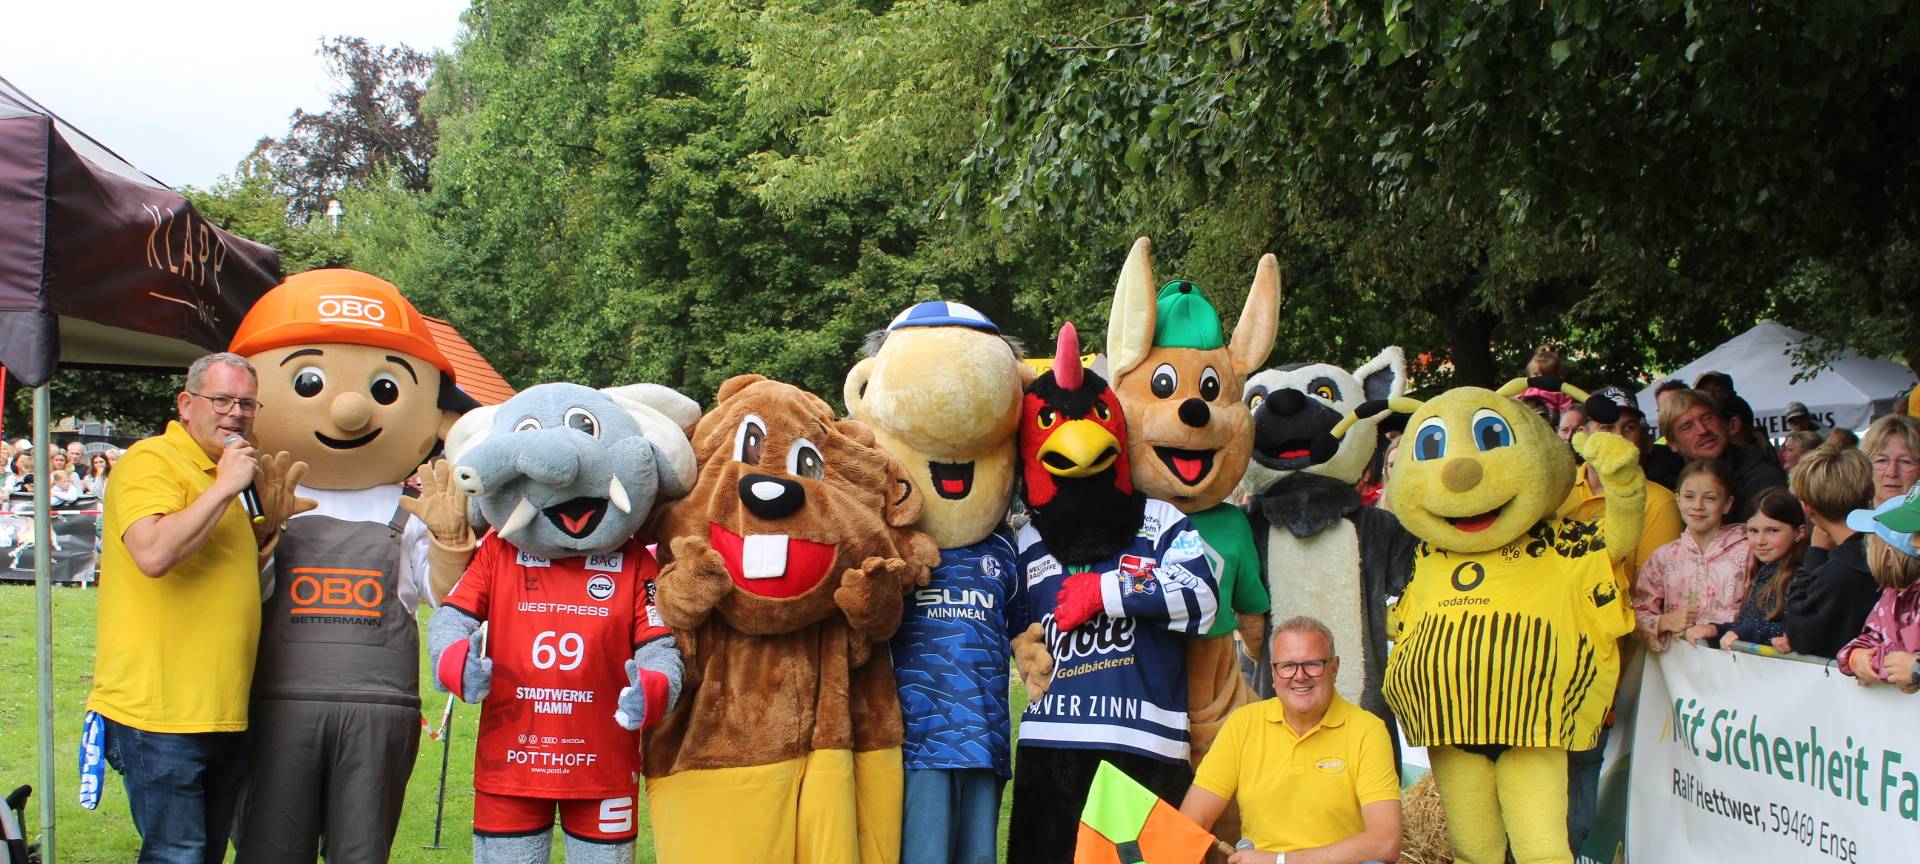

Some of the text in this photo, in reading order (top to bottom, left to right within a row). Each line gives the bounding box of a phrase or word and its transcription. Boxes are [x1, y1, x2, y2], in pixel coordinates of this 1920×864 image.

[318, 299, 385, 321] OBO
[1757, 411, 1836, 434] VELNS
[1501, 544, 1520, 559] BVB
[590, 554, 618, 568] BAG
[290, 575, 384, 608] OBO
[588, 582, 614, 591] ASV
[915, 588, 994, 609] SUN
[1438, 595, 1490, 608] vodafone
[518, 601, 609, 617] WESTPRESS
[927, 607, 987, 621] MINIMEAL
[290, 616, 381, 627] BETTERMANN
[532, 630, 585, 671] 69
[1056, 654, 1135, 680] Goldbäckerei
[516, 686, 594, 703] STADTWERKE
[534, 701, 573, 715] HAMM
[1089, 695, 1137, 720] ZINN
[506, 749, 597, 766] POTTHOFF
[1706, 708, 1869, 806] Sicherheit
[1672, 768, 1858, 864] Ralf Hettwer, 59469 Ense
